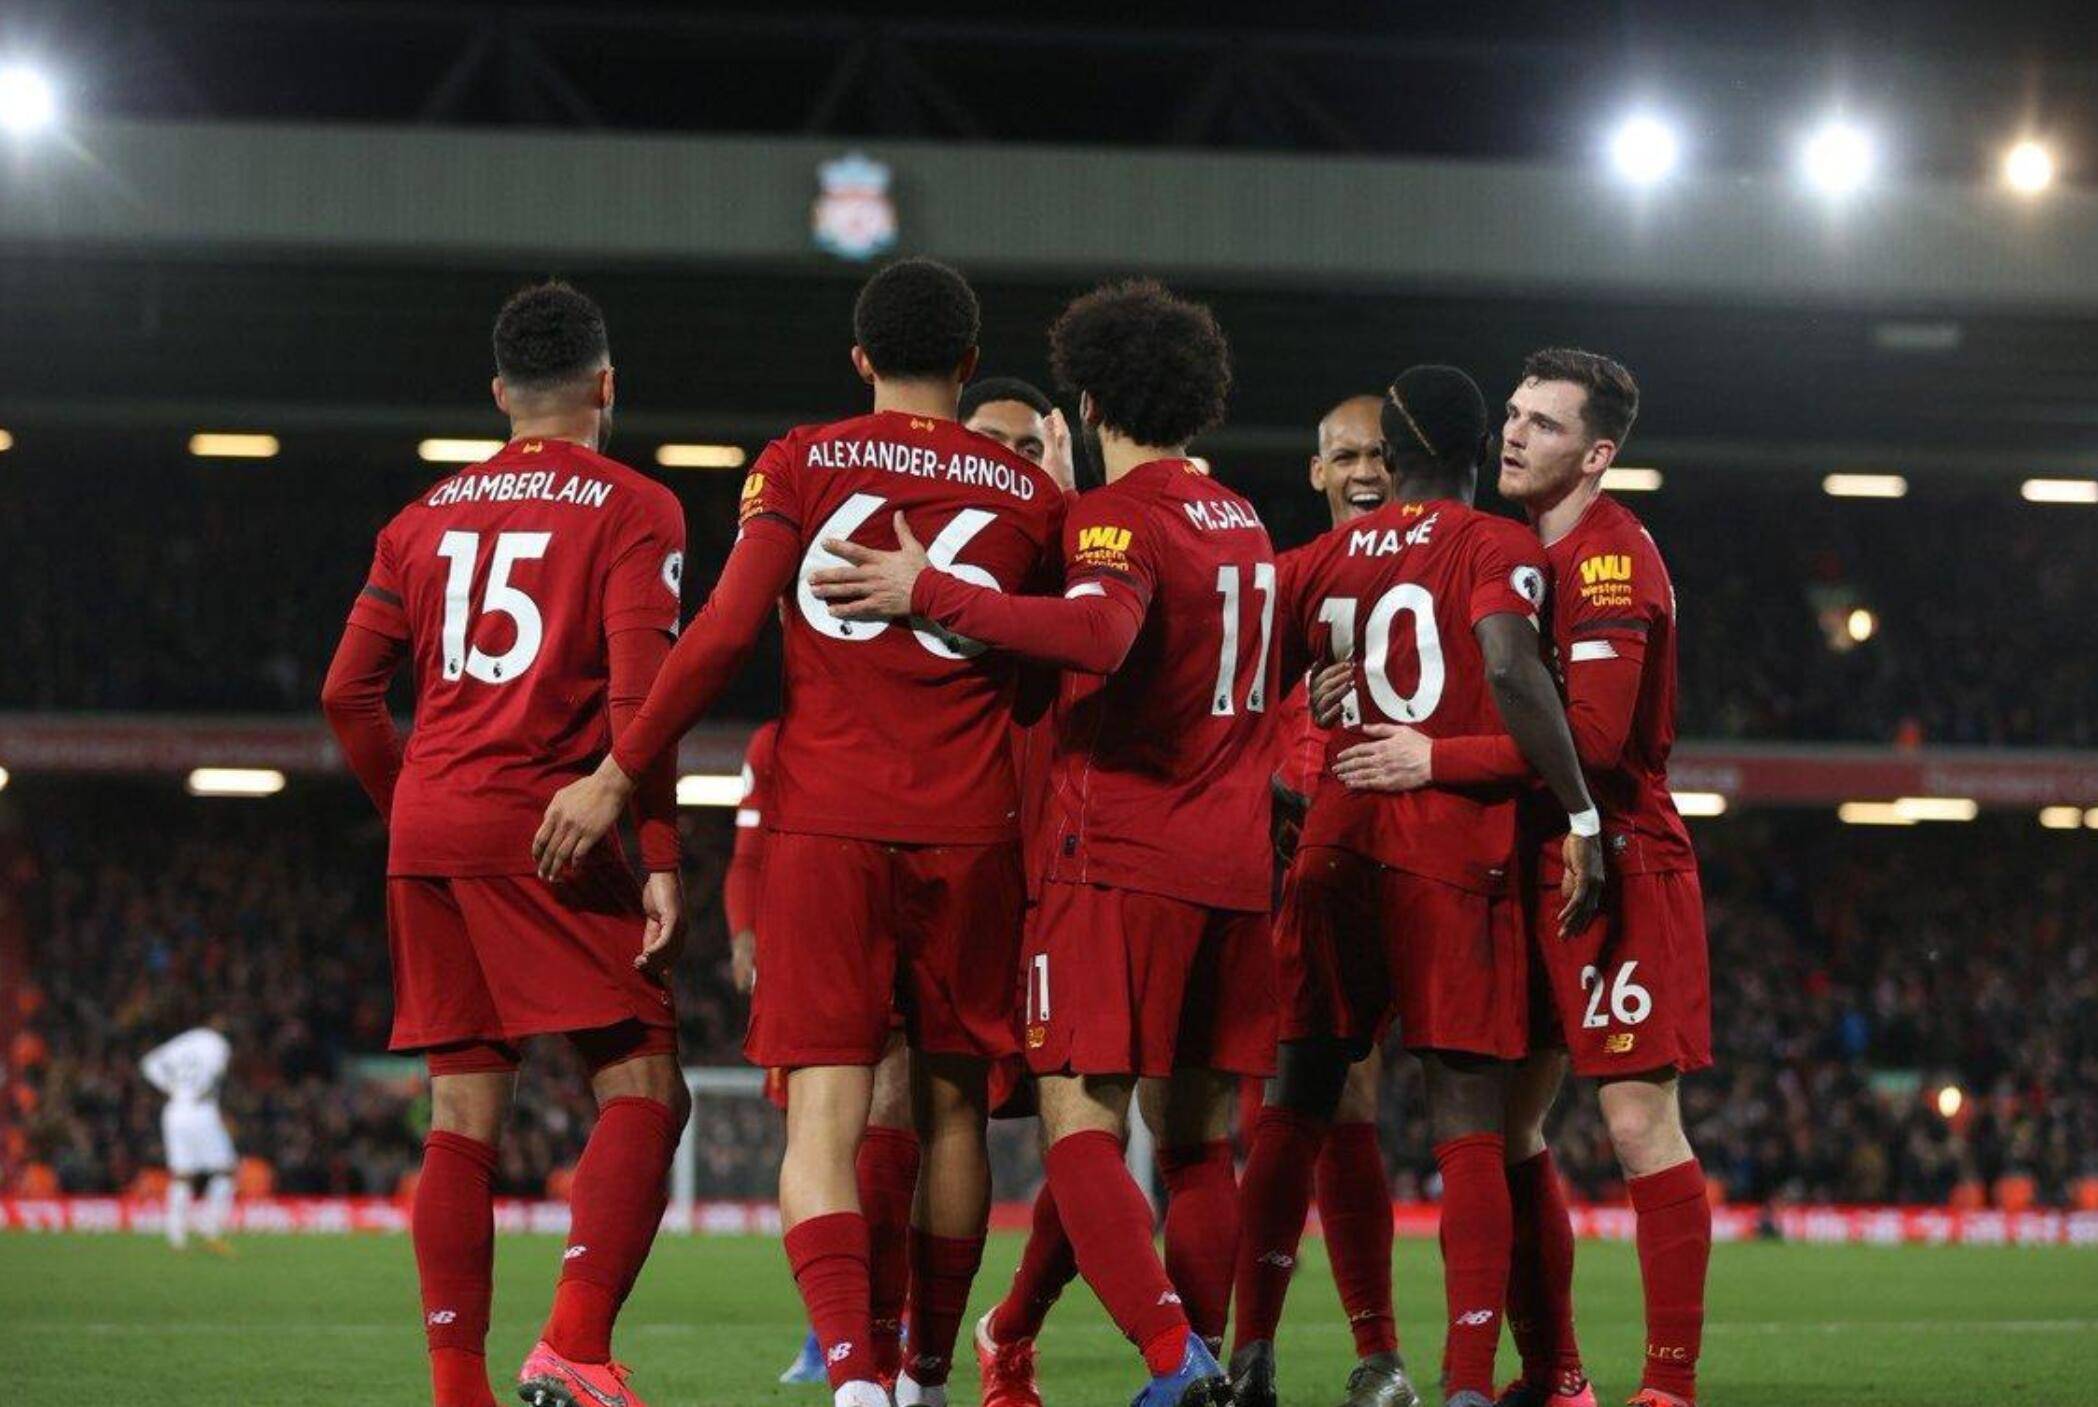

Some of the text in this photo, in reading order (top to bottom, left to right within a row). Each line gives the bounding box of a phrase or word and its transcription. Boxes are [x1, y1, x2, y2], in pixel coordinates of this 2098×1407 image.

[428, 471, 614, 508] CHAMBERLAIN
[741, 472, 765, 501] U
[807, 440, 1035, 501] ALEXANDER-ARNOLD
[1079, 525, 1133, 552] WU
[1580, 554, 1632, 585] WU
[436, 530, 553, 684] 15
[1211, 562, 1277, 716] 11
[1317, 582, 1446, 730] 10
[1580, 960, 1652, 1029] 26
